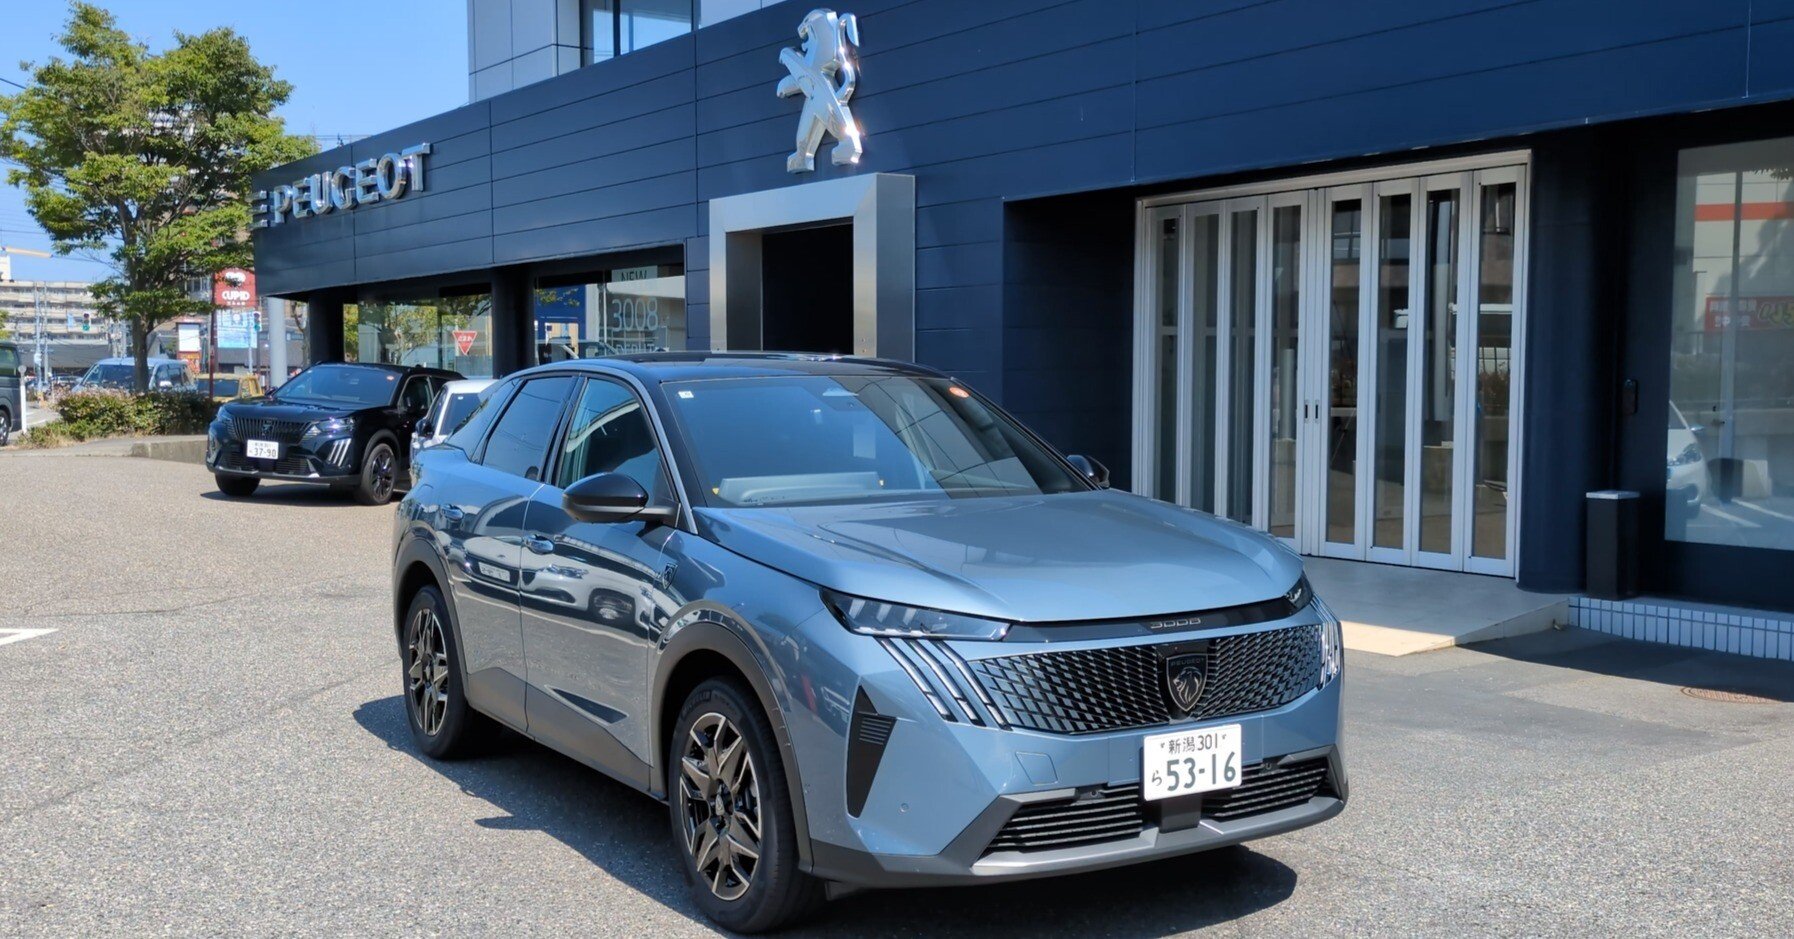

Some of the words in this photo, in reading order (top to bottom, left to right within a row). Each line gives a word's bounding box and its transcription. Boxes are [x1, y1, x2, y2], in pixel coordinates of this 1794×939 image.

[273, 142, 431, 224] PEUGEOT
[621, 269, 647, 280] NEW
[221, 290, 250, 301] CUPID
[611, 297, 659, 333] 3008
[253, 447, 277, 458] 37-90
[1151, 769, 1163, 787] ら
[1166, 751, 1236, 792] 53-16
